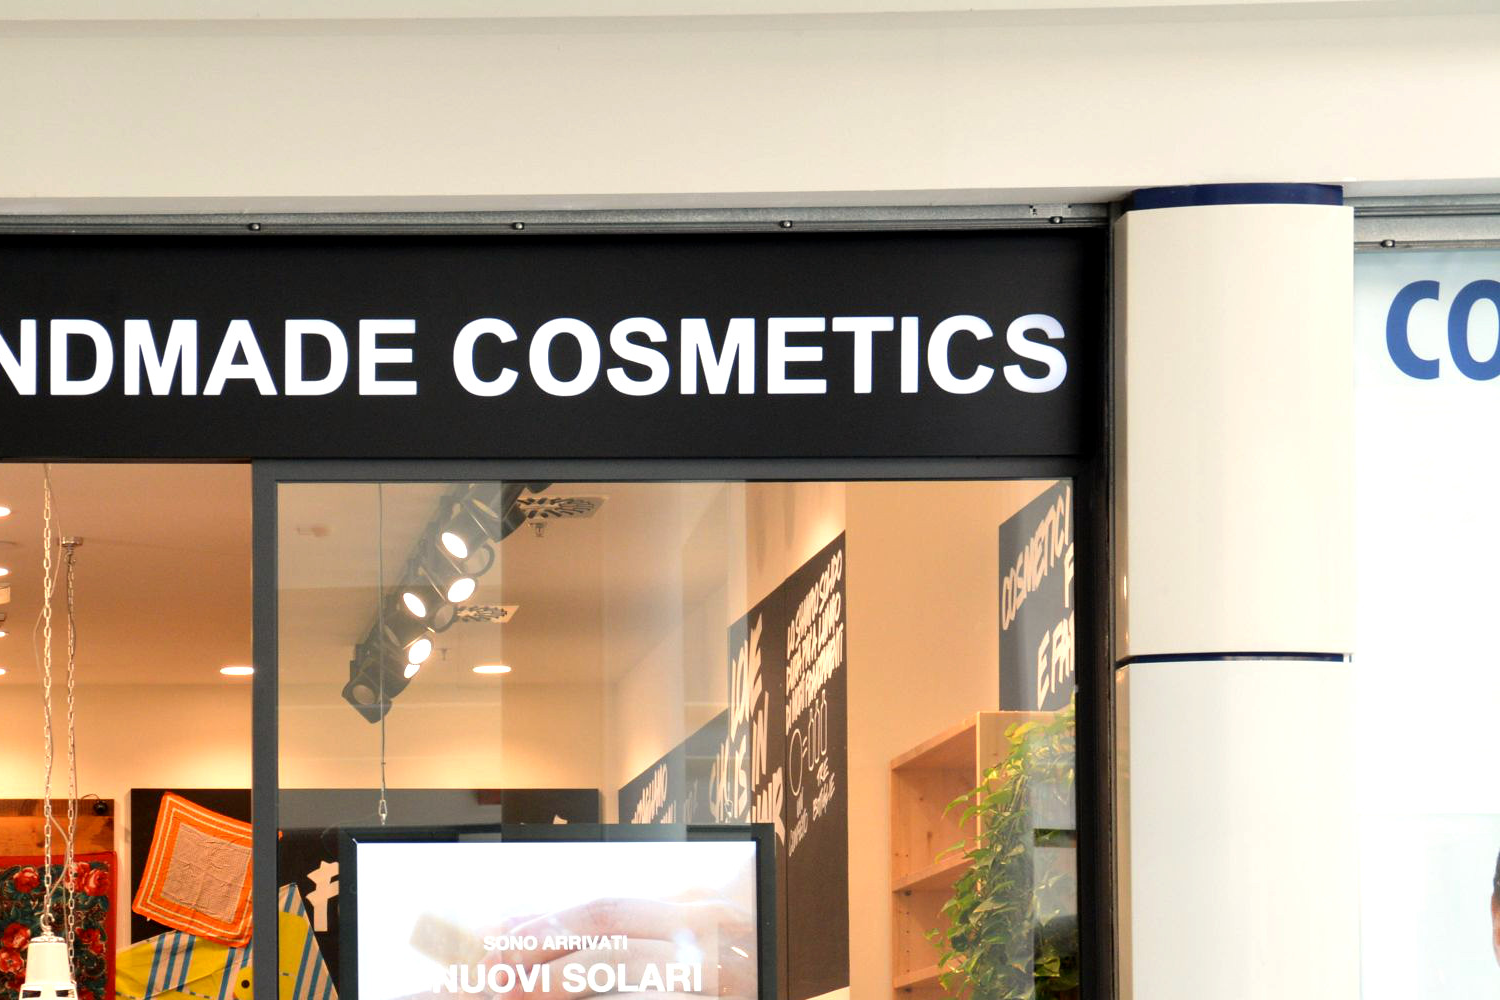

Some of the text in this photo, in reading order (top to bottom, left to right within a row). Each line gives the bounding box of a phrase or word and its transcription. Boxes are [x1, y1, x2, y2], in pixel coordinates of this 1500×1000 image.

[452, 313, 1068, 397] COSMETICS
[483, 935, 628, 950] SONO ARRIVATI
[432, 963, 703, 993] NUOVI SOLARI
